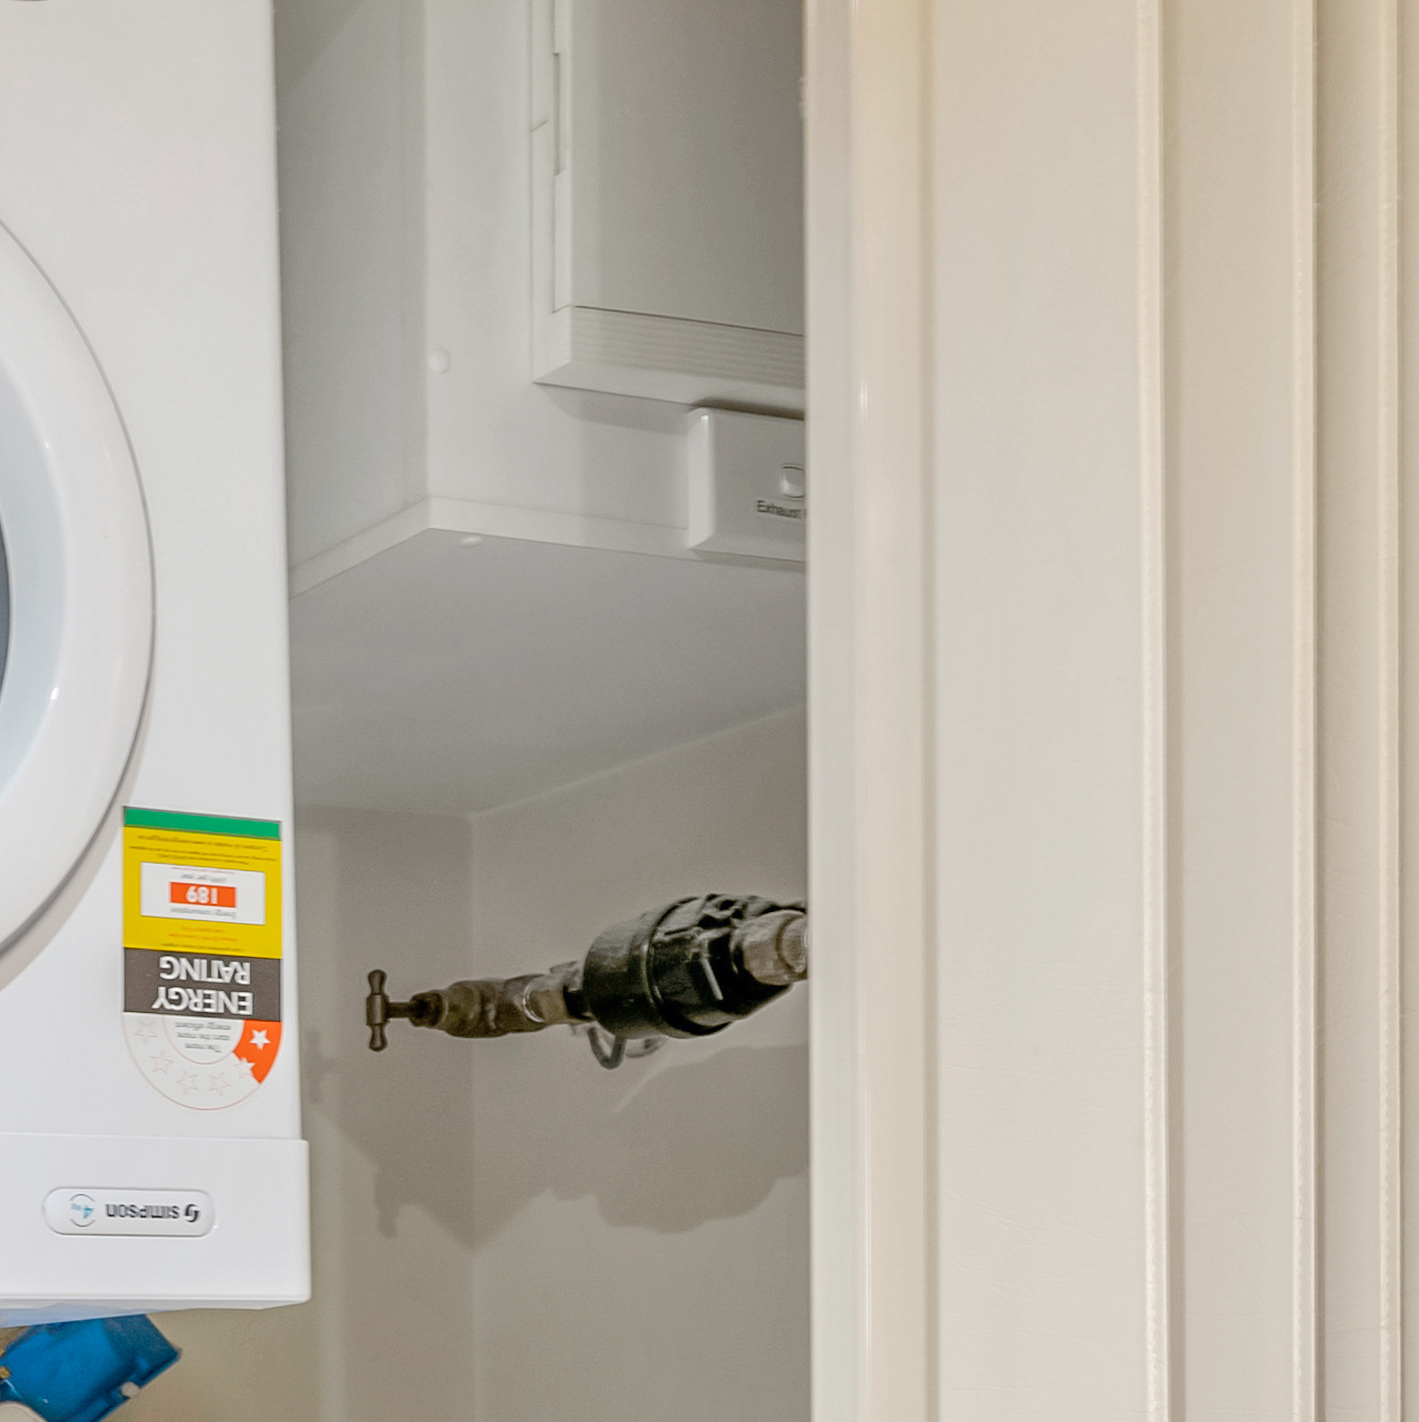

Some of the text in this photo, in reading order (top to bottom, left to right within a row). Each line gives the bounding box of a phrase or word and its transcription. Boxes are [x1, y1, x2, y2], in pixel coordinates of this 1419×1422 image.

[757, 500, 801, 519] Exhaust
[186, 886, 218, 905] 189
[159, 955, 250, 984] RATING
[151, 986, 253, 1015] ENERGY
